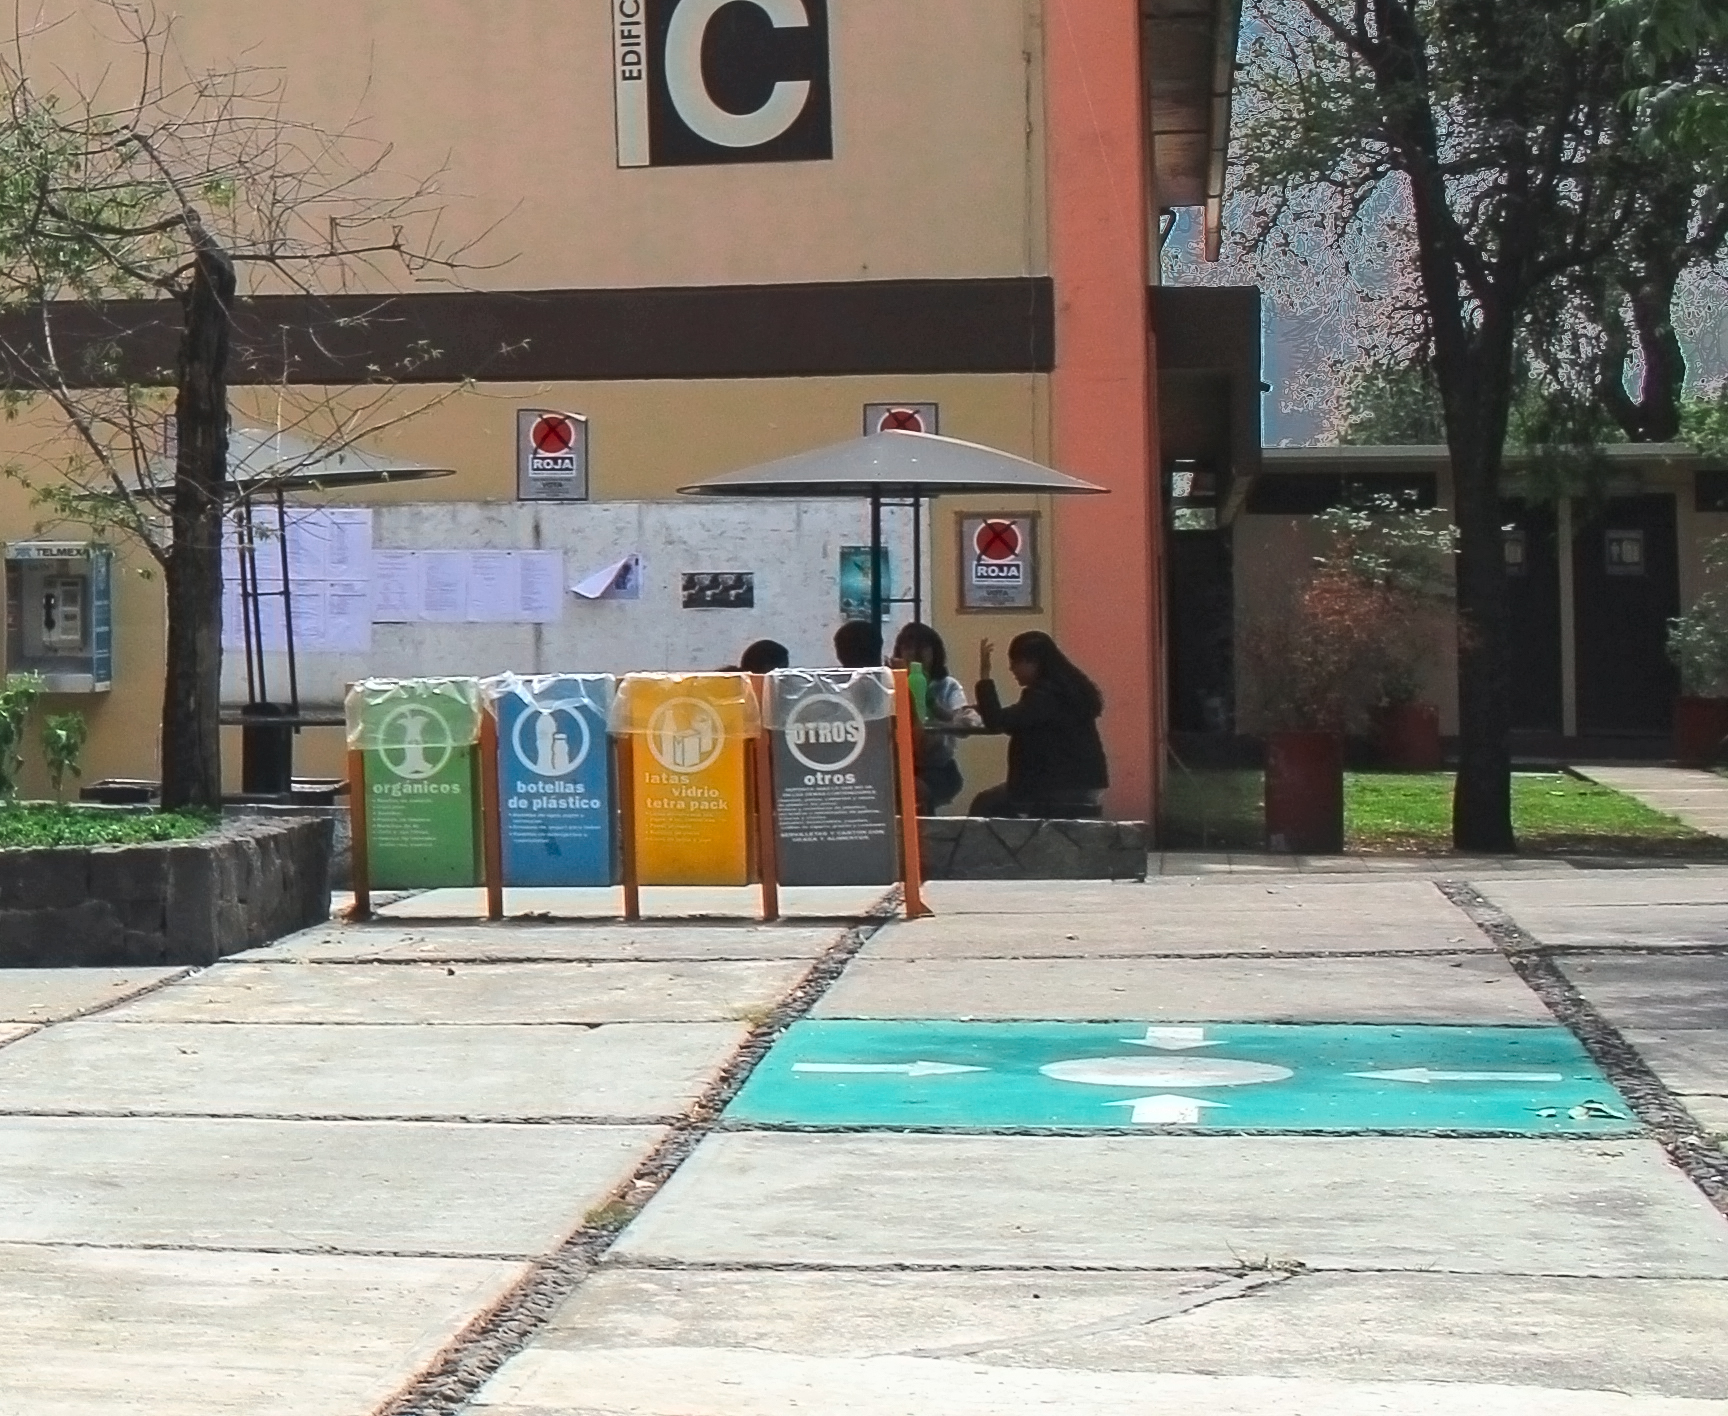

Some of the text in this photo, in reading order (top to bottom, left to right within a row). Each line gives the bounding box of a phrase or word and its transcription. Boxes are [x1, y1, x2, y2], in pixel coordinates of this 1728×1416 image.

[533, 459, 573, 469] ROJA
[36, 548, 82, 556] TELMEX
[977, 566, 1019, 577] ROJA
[793, 720, 859, 744] OTROS
[645, 772, 690, 785] latas
[804, 772, 856, 786] otros
[372, 780, 461, 797] orgánicos
[516, 780, 585, 794] botellas
[671, 785, 719, 798] vidrio
[507, 795, 601, 812] de plástico
[646, 798, 728, 811] tetra pack
